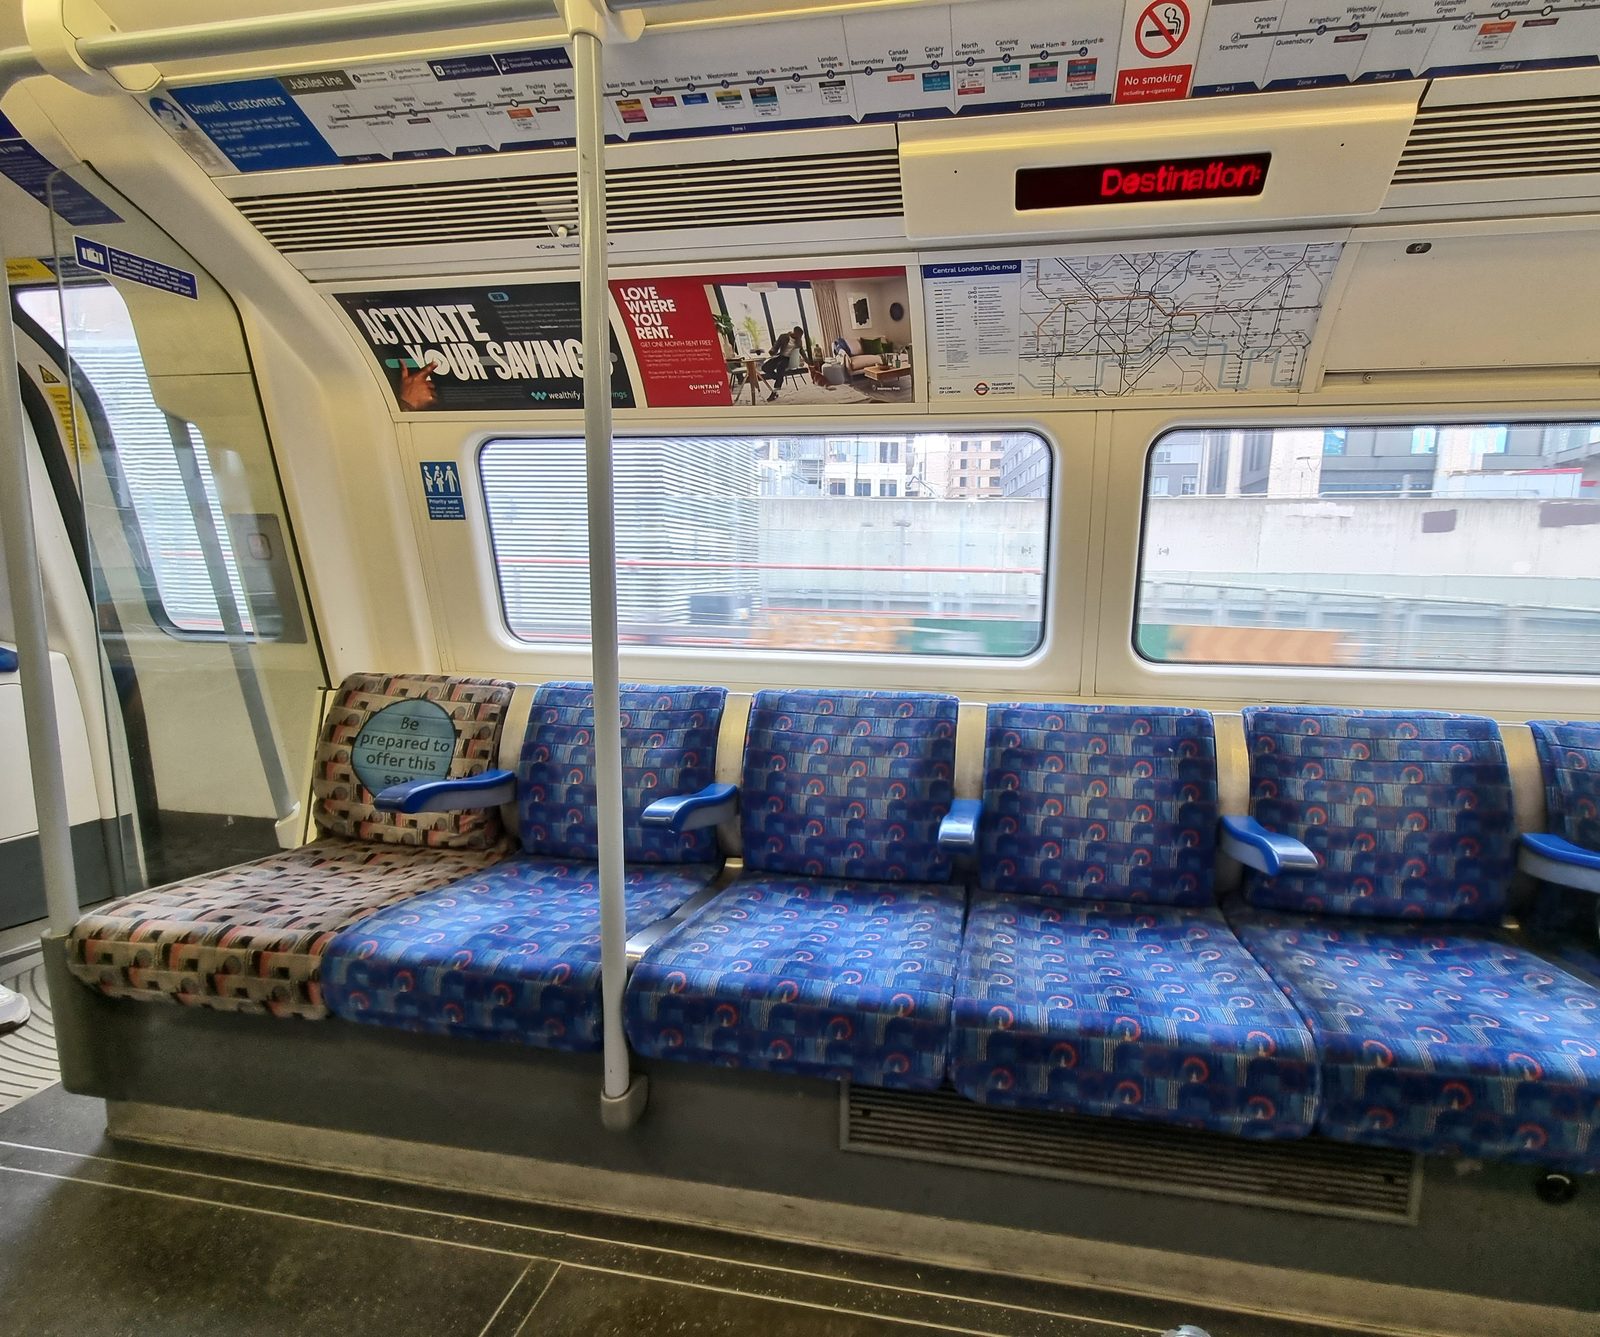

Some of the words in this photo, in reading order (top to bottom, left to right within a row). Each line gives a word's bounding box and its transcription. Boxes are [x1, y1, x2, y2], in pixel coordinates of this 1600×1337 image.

[1309, 16, 1342, 24] Kingsbury
[995, 39, 1019, 47] Canning
[1071, 38, 1097, 46] Stratford
[1276, 38, 1313, 46] Queensbury
[955, 48, 985, 56] Greenwich
[851, 58, 884, 66] Bermondsey
[289, 76, 324, 90] Jubilee
[325, 75, 344, 86] line
[707, 72, 738, 80] Westminster
[1124, 76, 1140, 86] No
[1142, 73, 1183, 85] smoking
[186, 100, 227, 115] Unwell
[228, 96, 286, 110] customers
[620, 286, 659, 301] LOVE
[625, 299, 676, 313] WHERE
[356, 304, 490, 345] ACTIVATE
[630, 314, 662, 326] YOU
[635, 326, 673, 340] RENT.
[404, 344, 489, 381] YOUR
[487, 338, 614, 380] SAVING
[549, 391, 580, 400] wealthify
[401, 716, 419, 731] Be
[360, 733, 430, 751] prepared
[433, 740, 450, 752] to
[366, 752, 405, 767] offer
[408, 753, 436, 771] this
